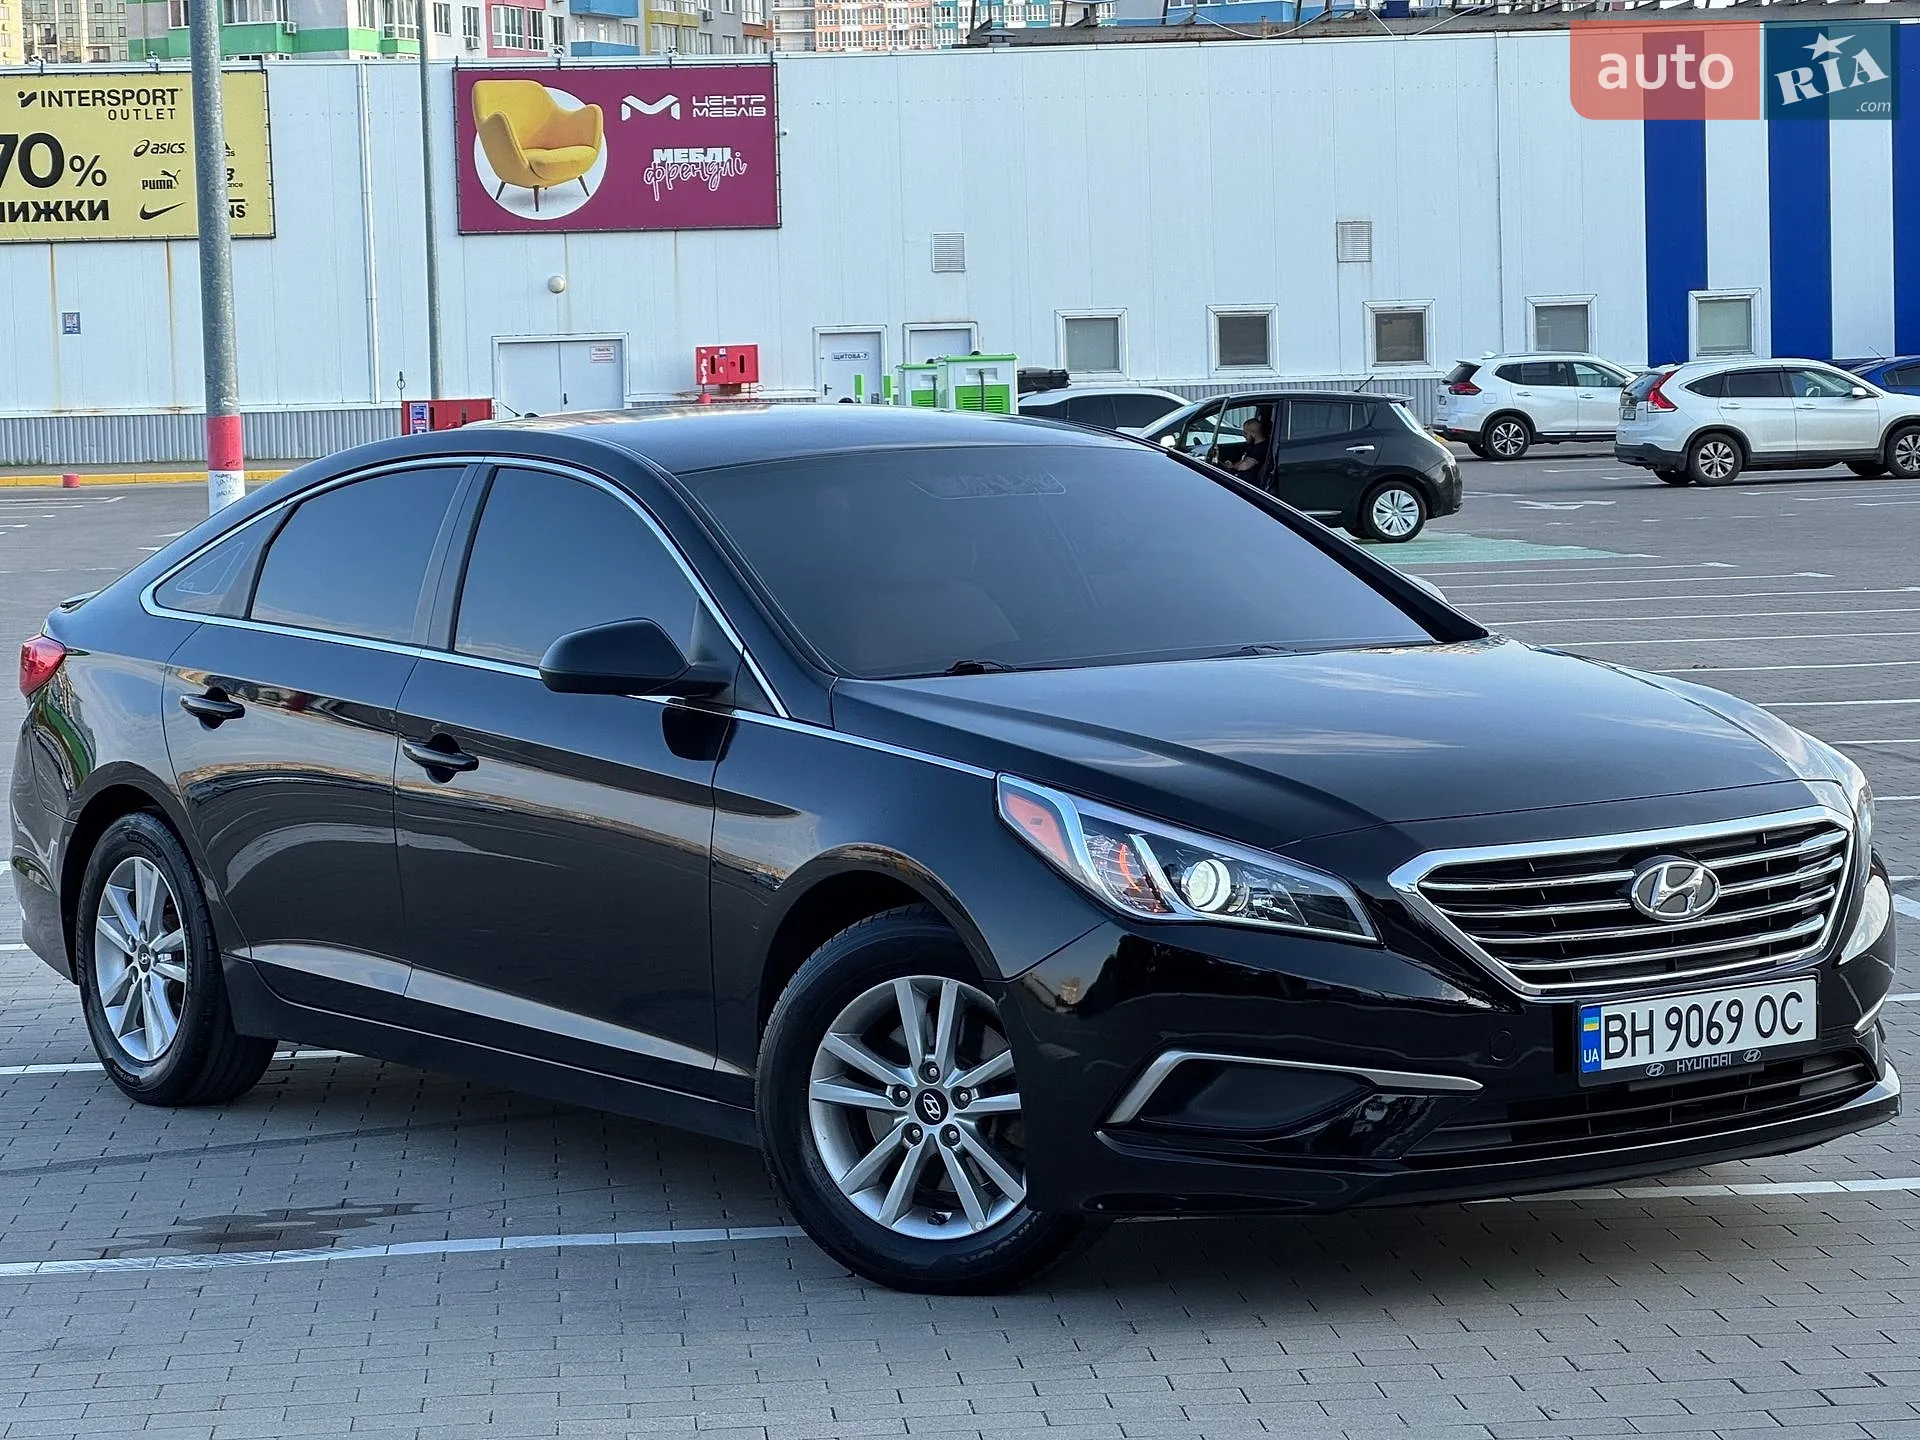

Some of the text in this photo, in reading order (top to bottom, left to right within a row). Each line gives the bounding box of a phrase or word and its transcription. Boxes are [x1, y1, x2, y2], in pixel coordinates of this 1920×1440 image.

[41, 88, 179, 108] INTERSPORT
[692, 95, 767, 108] ЦЕНТР
[108, 108, 176, 121] OUTLET
[692, 106, 767, 118] МЕБЛІВ
[150, 142, 186, 154] asics
[653, 147, 731, 164] МЕБЛІ
[142, 179, 174, 190] PUMA
[1603, 991, 1804, 1061] BH 9069 OC
[1583, 1047, 1600, 1063] UA
[1676, 1052, 1732, 1073] HYUNDAI
